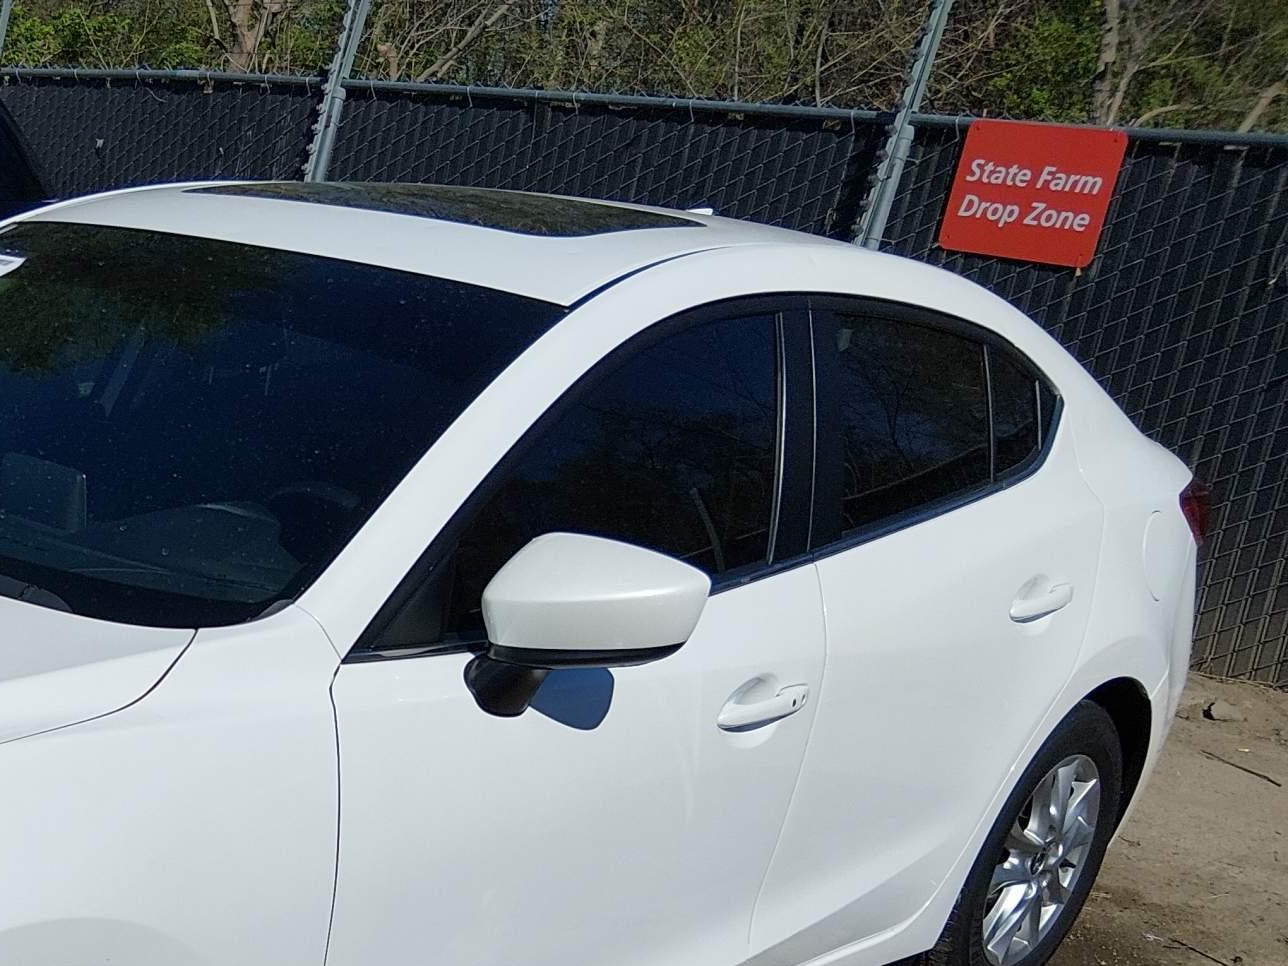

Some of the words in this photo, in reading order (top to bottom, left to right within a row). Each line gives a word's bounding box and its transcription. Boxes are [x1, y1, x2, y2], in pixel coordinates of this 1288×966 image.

[966, 159, 1032, 187] State
[1036, 166, 1103, 195] Farm
[958, 194, 1020, 228] Drop
[1023, 202, 1090, 232] Zone
